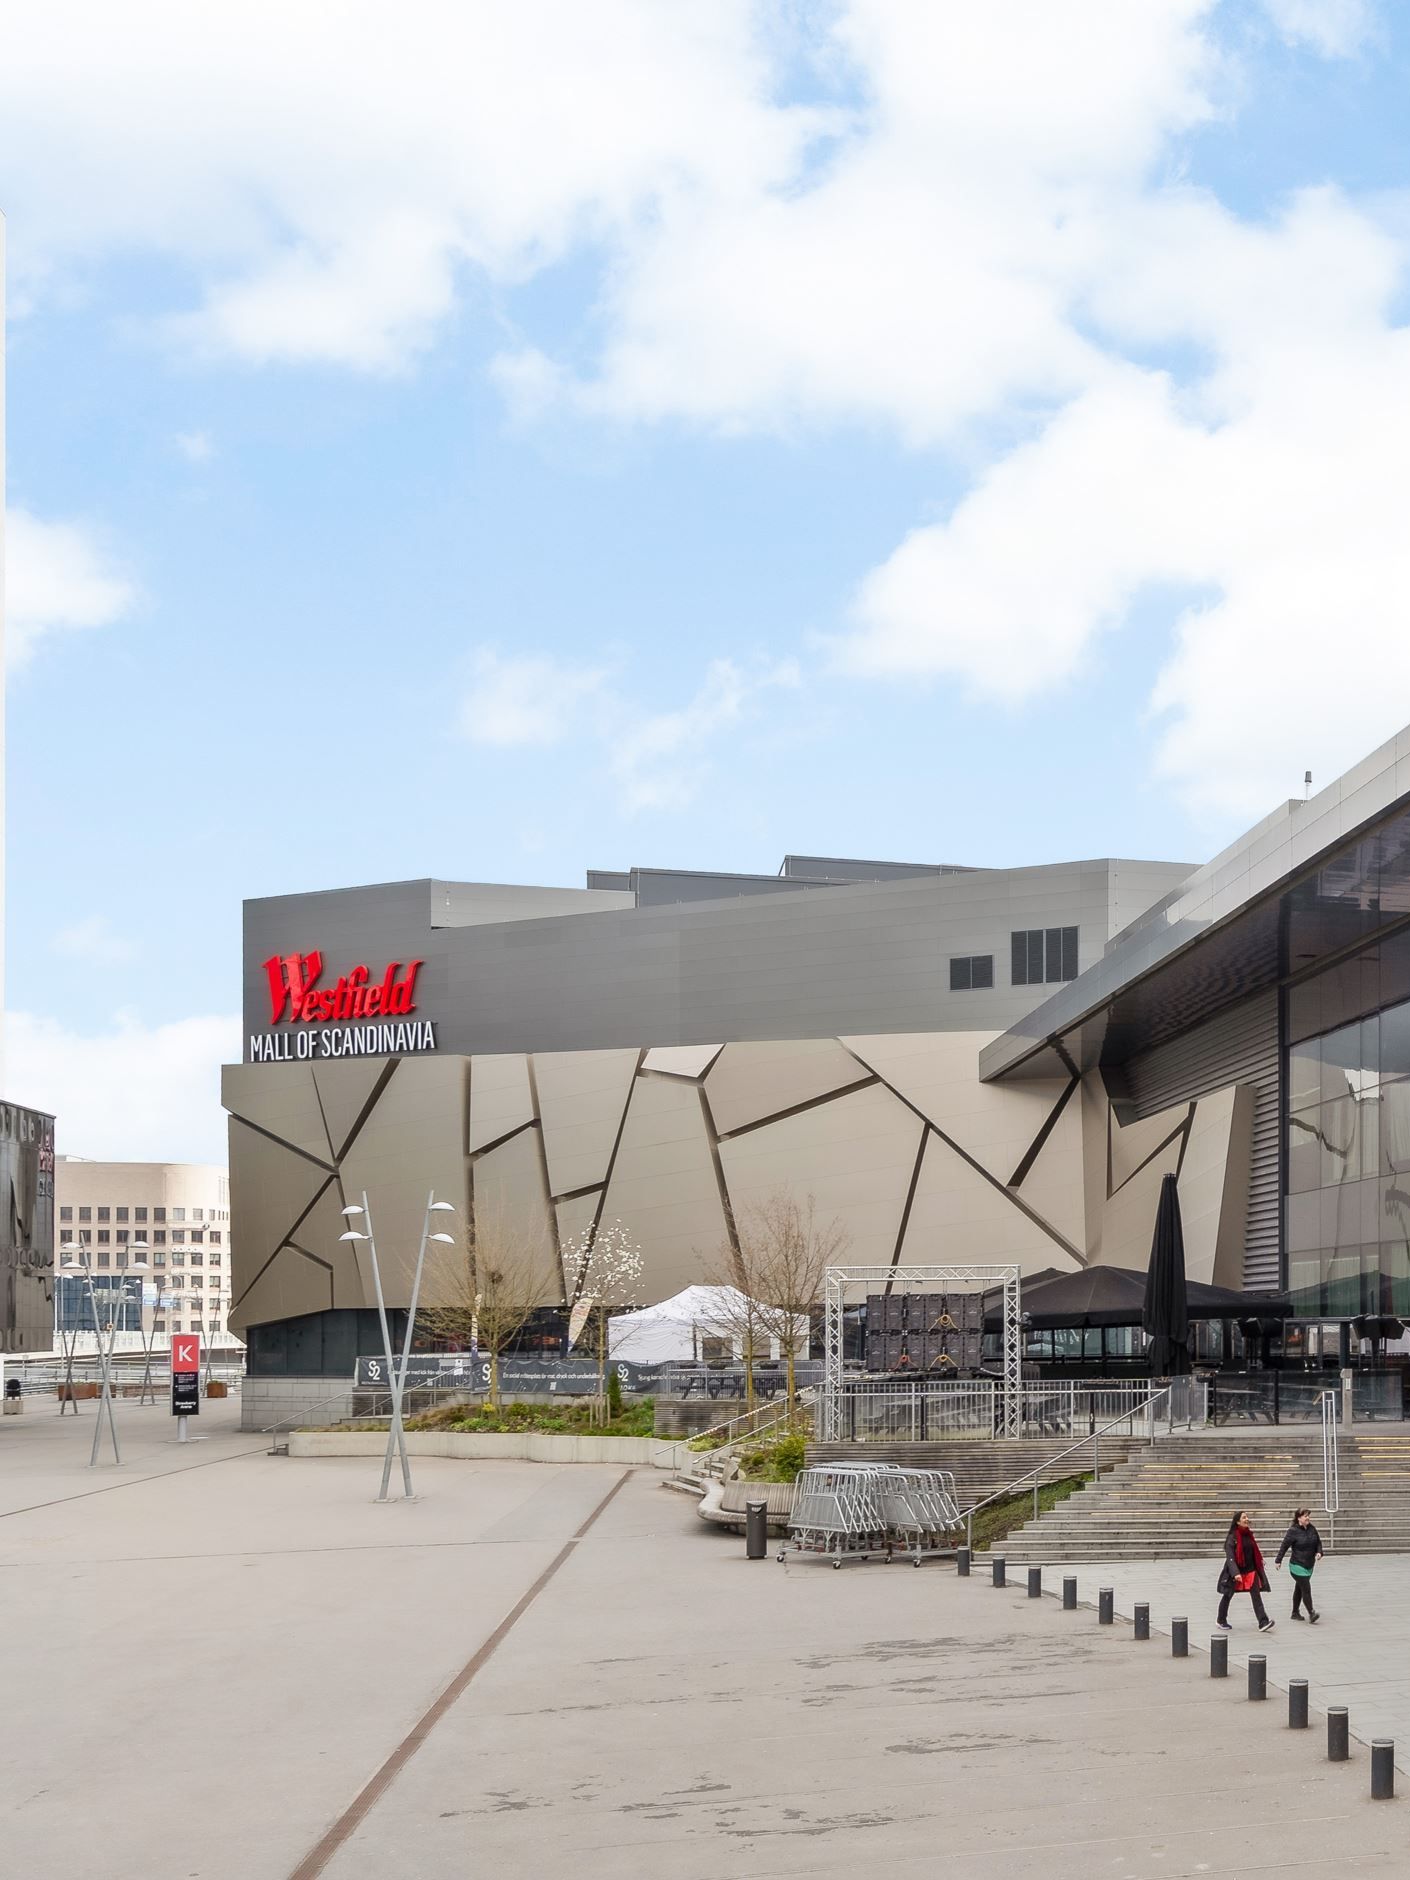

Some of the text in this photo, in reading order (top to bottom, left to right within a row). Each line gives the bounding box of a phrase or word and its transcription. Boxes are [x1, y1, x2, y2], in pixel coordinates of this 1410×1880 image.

[262, 949, 424, 1025] Westfield
[250, 1021, 435, 1062] MALL OF SCANDINAVIA
[178, 1345, 193, 1361] K
[368, 1360, 380, 1380] S2
[617, 1363, 629, 1381] S2
